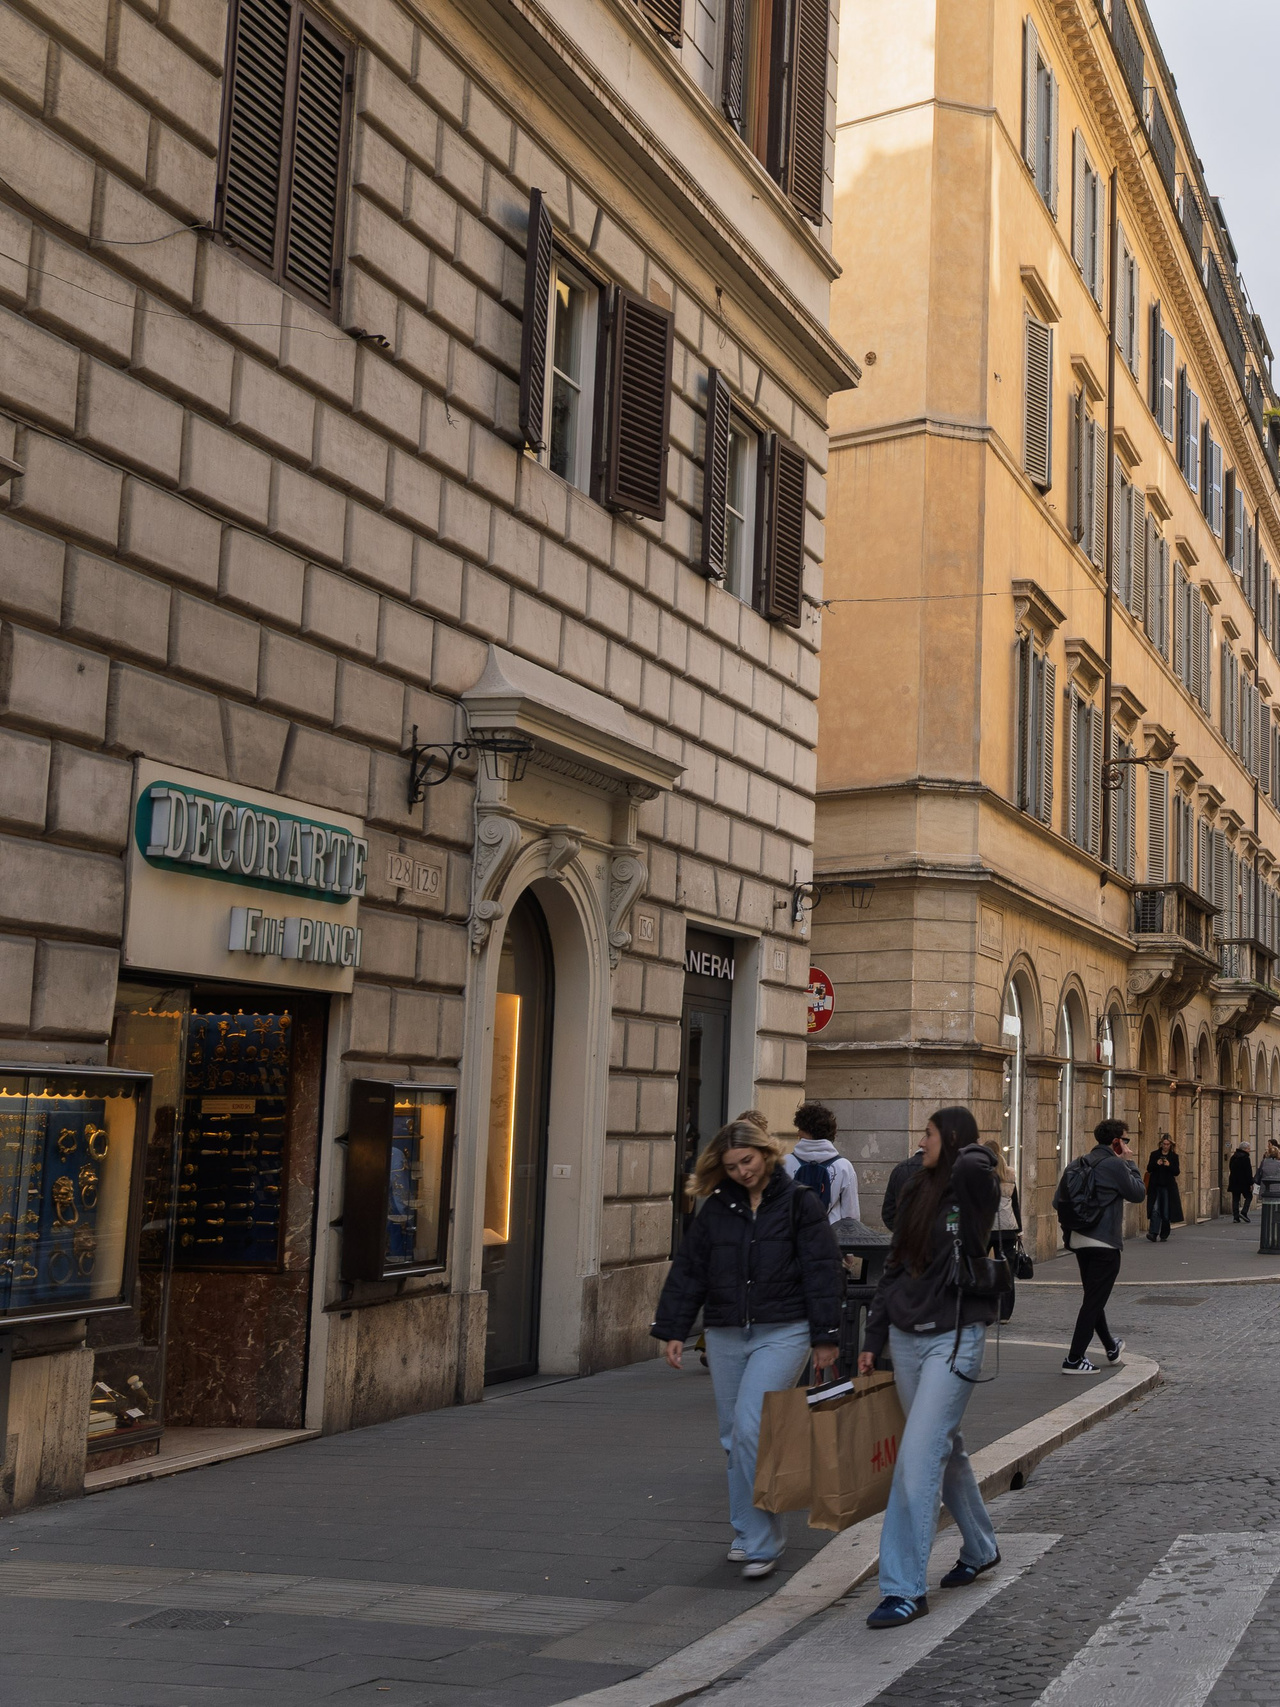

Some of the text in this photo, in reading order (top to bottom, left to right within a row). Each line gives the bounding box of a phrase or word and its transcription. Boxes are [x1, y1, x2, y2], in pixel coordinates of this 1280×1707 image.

[148, 787, 369, 898] DECORARTE
[390, 856, 411, 883] 128
[416, 867, 438, 893] 129
[640, 918, 653, 939] 130
[293, 917, 363, 968] PINCI
